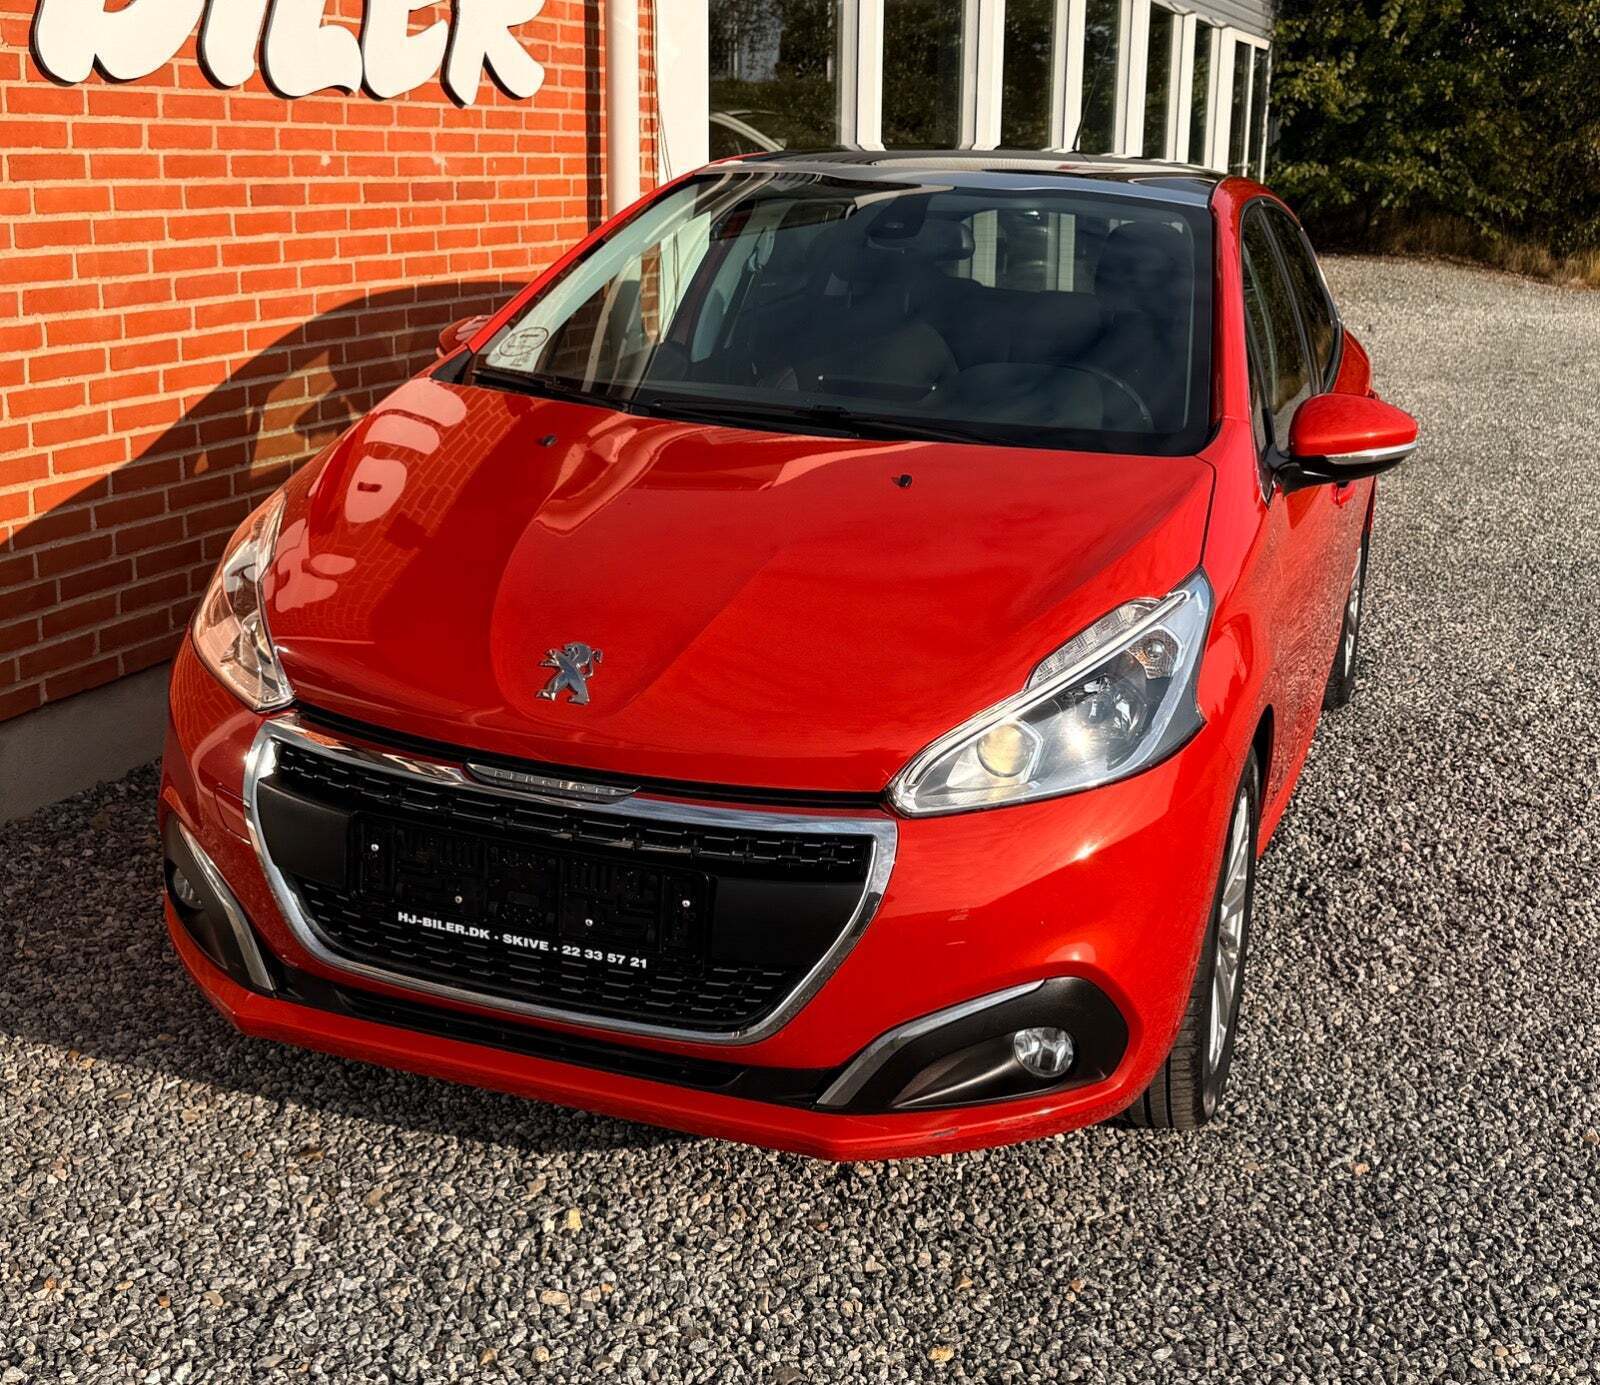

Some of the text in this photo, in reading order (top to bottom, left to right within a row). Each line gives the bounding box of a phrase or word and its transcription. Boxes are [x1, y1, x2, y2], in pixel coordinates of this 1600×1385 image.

[398, 911, 490, 940] HJ-BILER.DK
[502, 933, 549, 951] SKIVE
[562, 945, 581, 957] 22
[584, 949, 603, 961] 33
[607, 952, 626, 964] 57
[630, 957, 647, 969] 21
